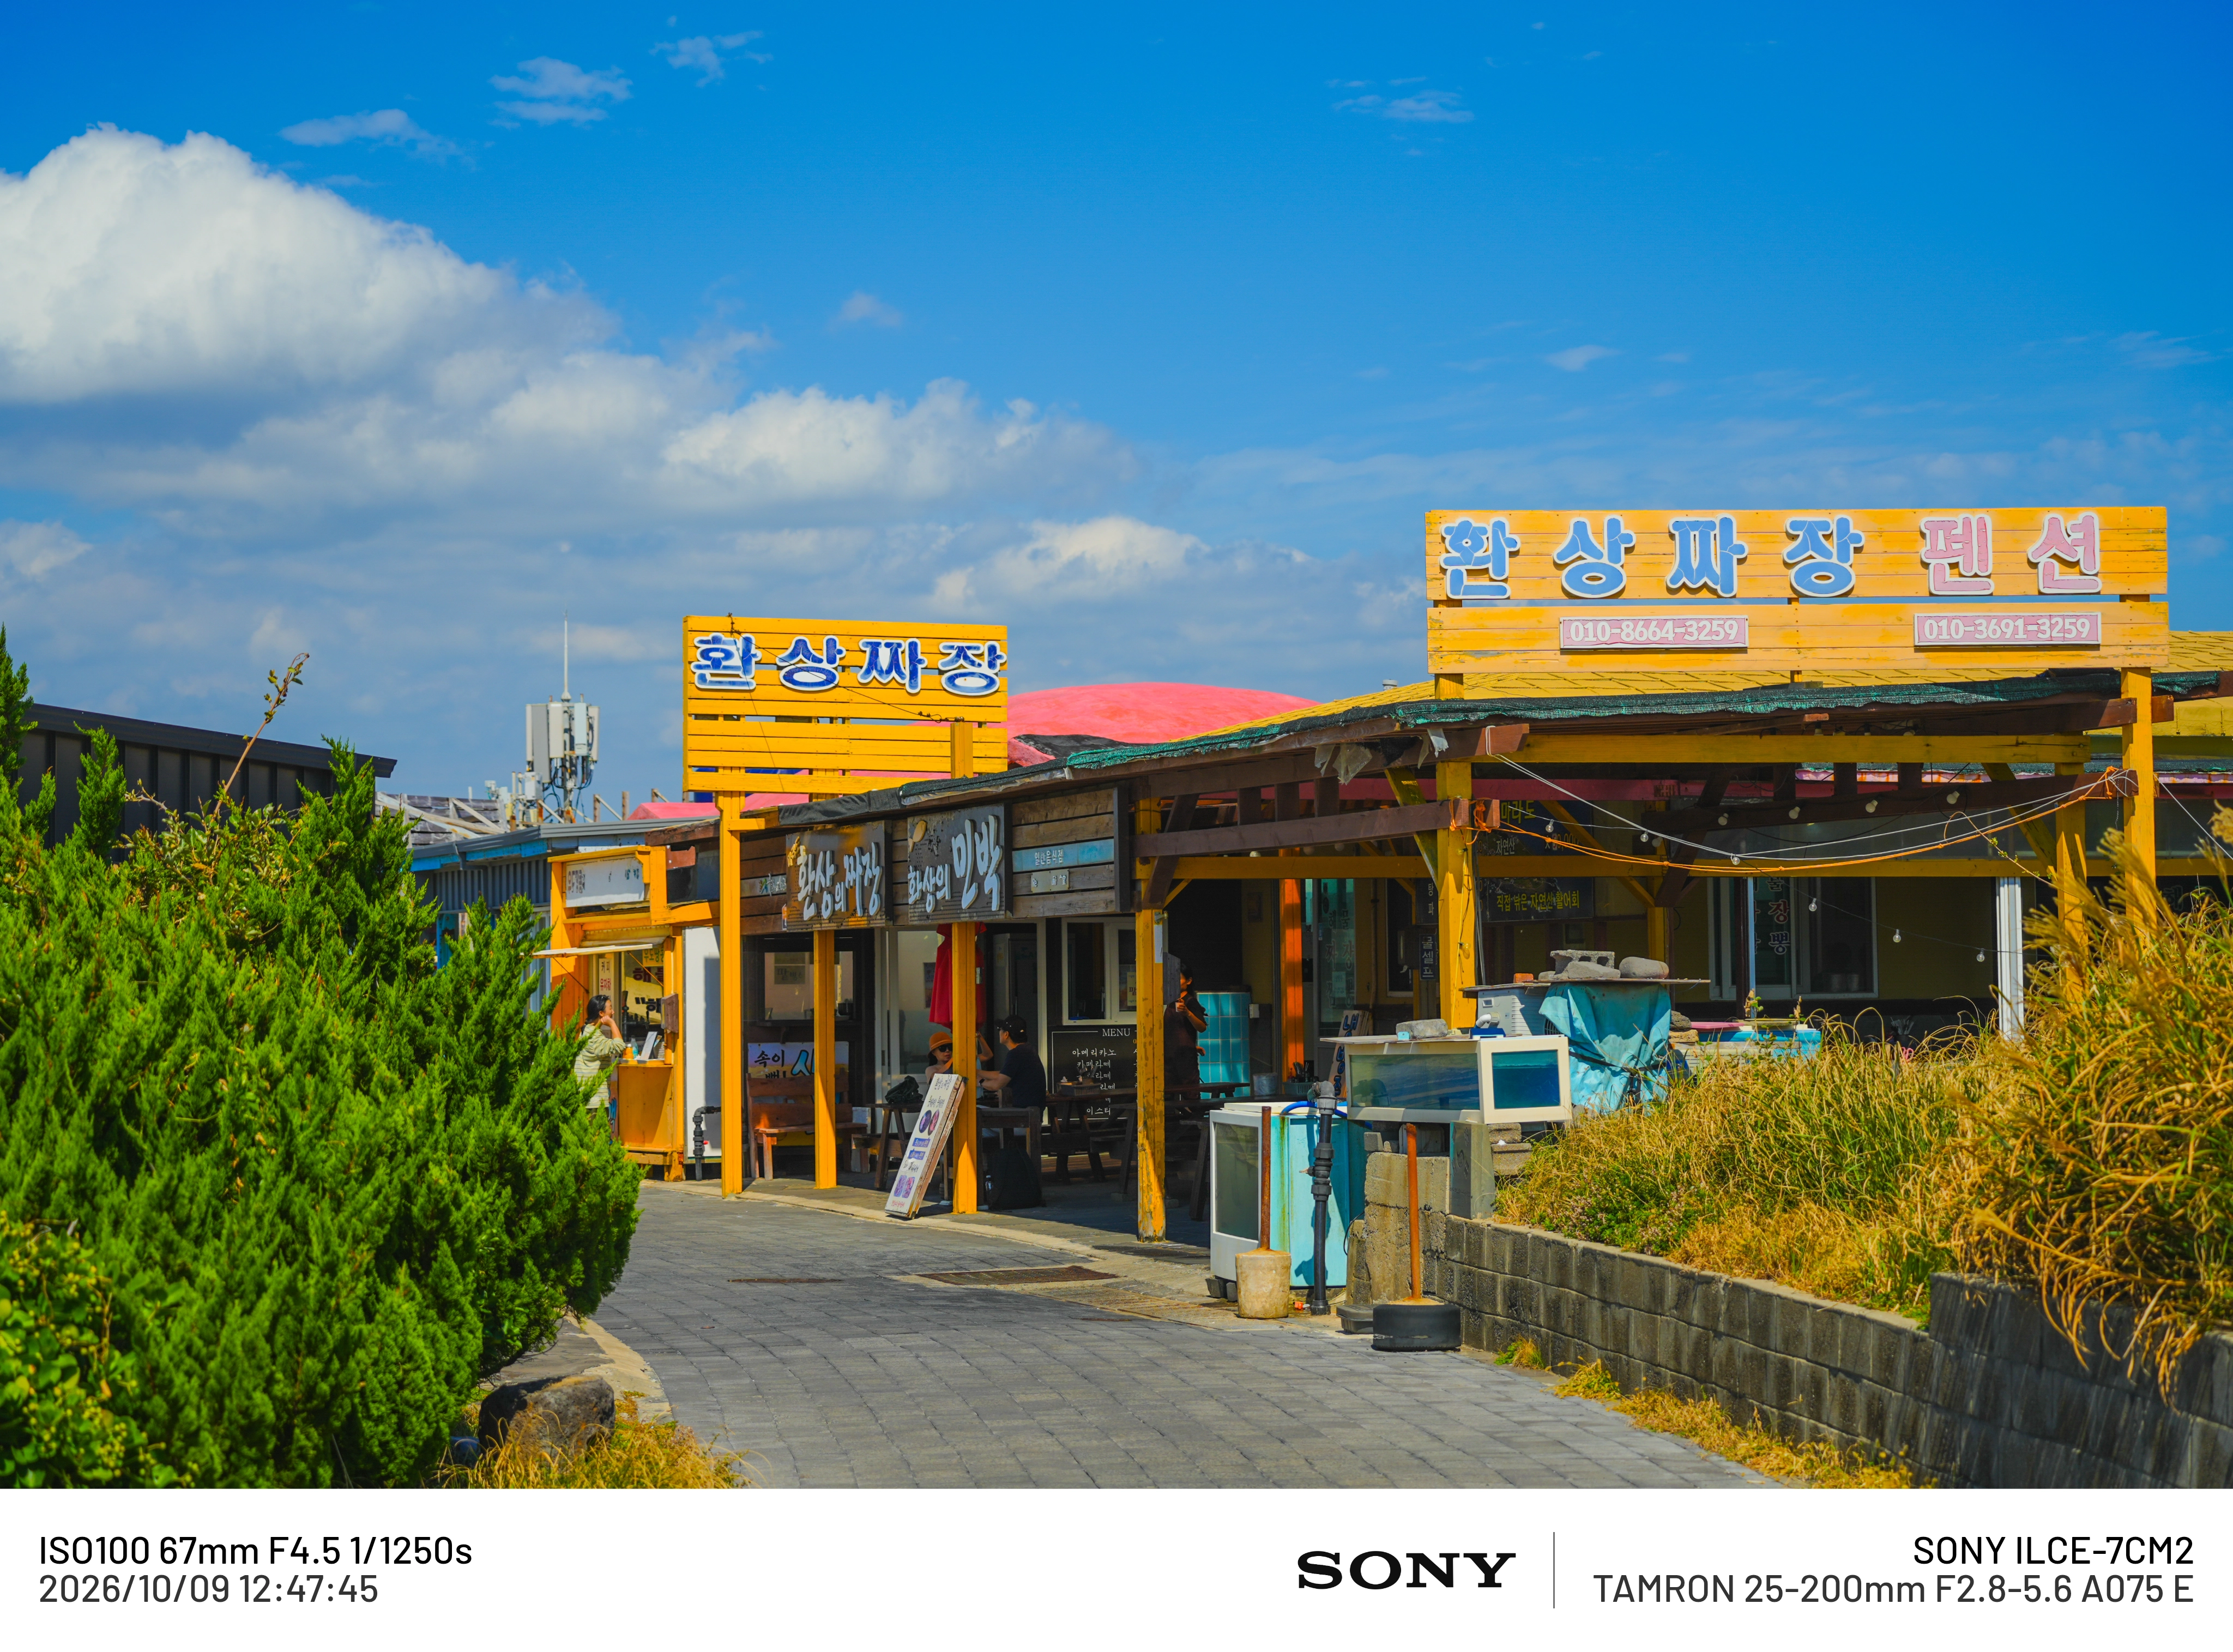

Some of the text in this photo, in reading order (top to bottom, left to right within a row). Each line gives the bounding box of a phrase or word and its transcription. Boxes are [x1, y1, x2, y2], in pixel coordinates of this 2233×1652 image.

[1920, 511, 2102, 595] 펜션
[1570, 619, 1739, 643] 010-8664-3259
[1923, 616, 2091, 641] 010-3691-3259
[1496, 837, 1515, 856] 자연산
[951, 815, 1003, 911] 민박
[1496, 894, 1511, 912] 직접
[1530, 891, 1554, 911] 자연산
[1555, 890, 1580, 909] 활어회
[1102, 1028, 1131, 1036] MENU
[755, 1049, 785, 1068] 속이
[1072, 1048, 1116, 1057] 아메리카노
[1087, 1106, 1111, 1115] 이스티
